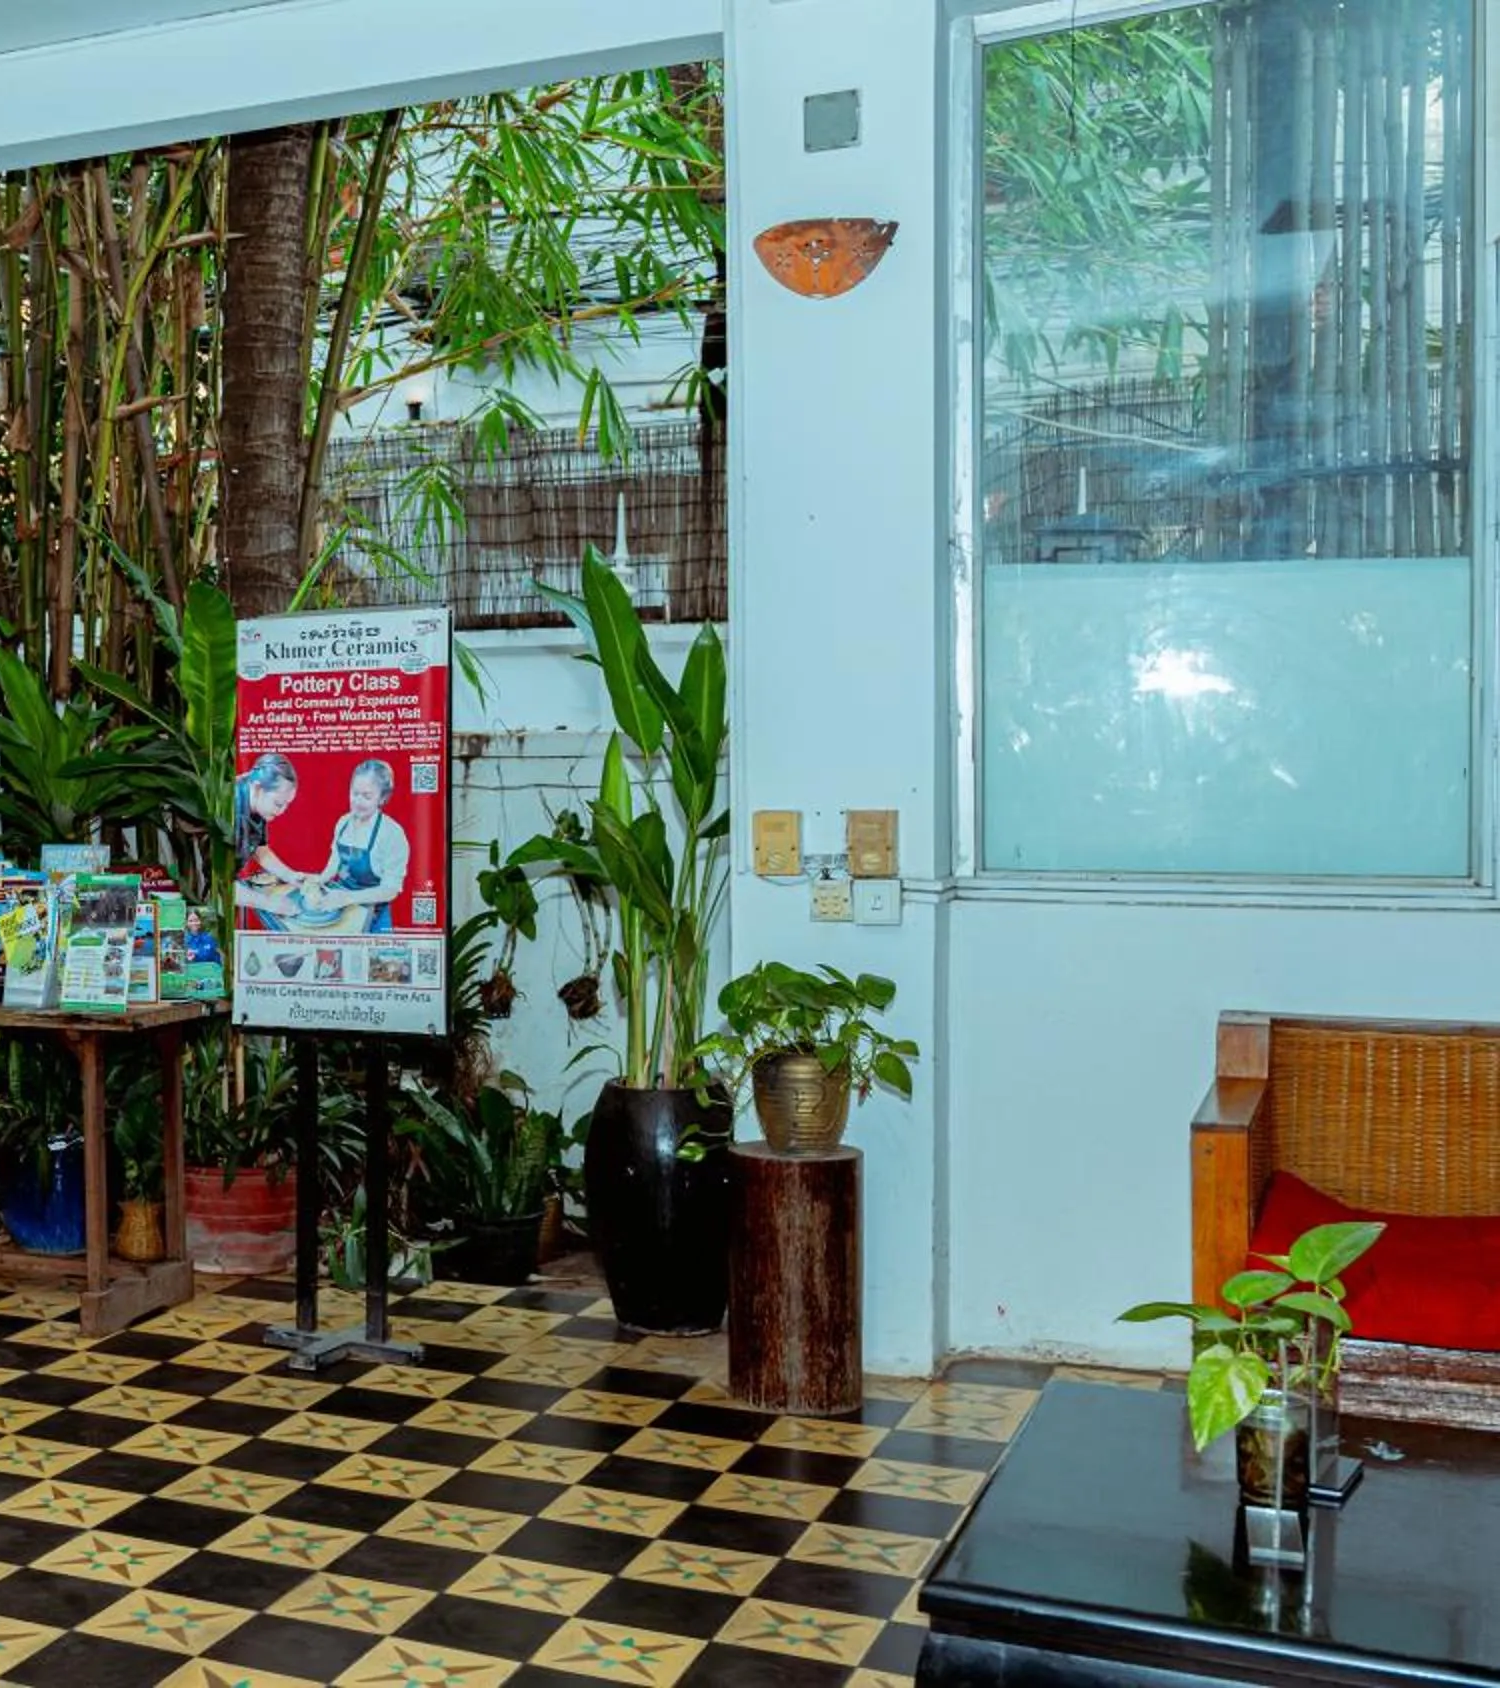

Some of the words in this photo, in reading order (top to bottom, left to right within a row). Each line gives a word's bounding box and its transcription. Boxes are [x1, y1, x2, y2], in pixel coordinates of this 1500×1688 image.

[265, 642, 327, 660] Khmer
[331, 637, 418, 656] Ceramics
[280, 675, 344, 696] Pottery
[349, 672, 400, 691] Class
[263, 698, 292, 710] Local
[294, 697, 356, 711] Community
[358, 694, 419, 708] Experience
[248, 713, 265, 724] Art
[267, 712, 305, 726] Gallery
[313, 711, 337, 722] Free
[339, 710, 394, 723] Workshop
[397, 708, 421, 719] Visit
[385, 990, 409, 1002] Fine
[410, 992, 431, 1003] Arts
